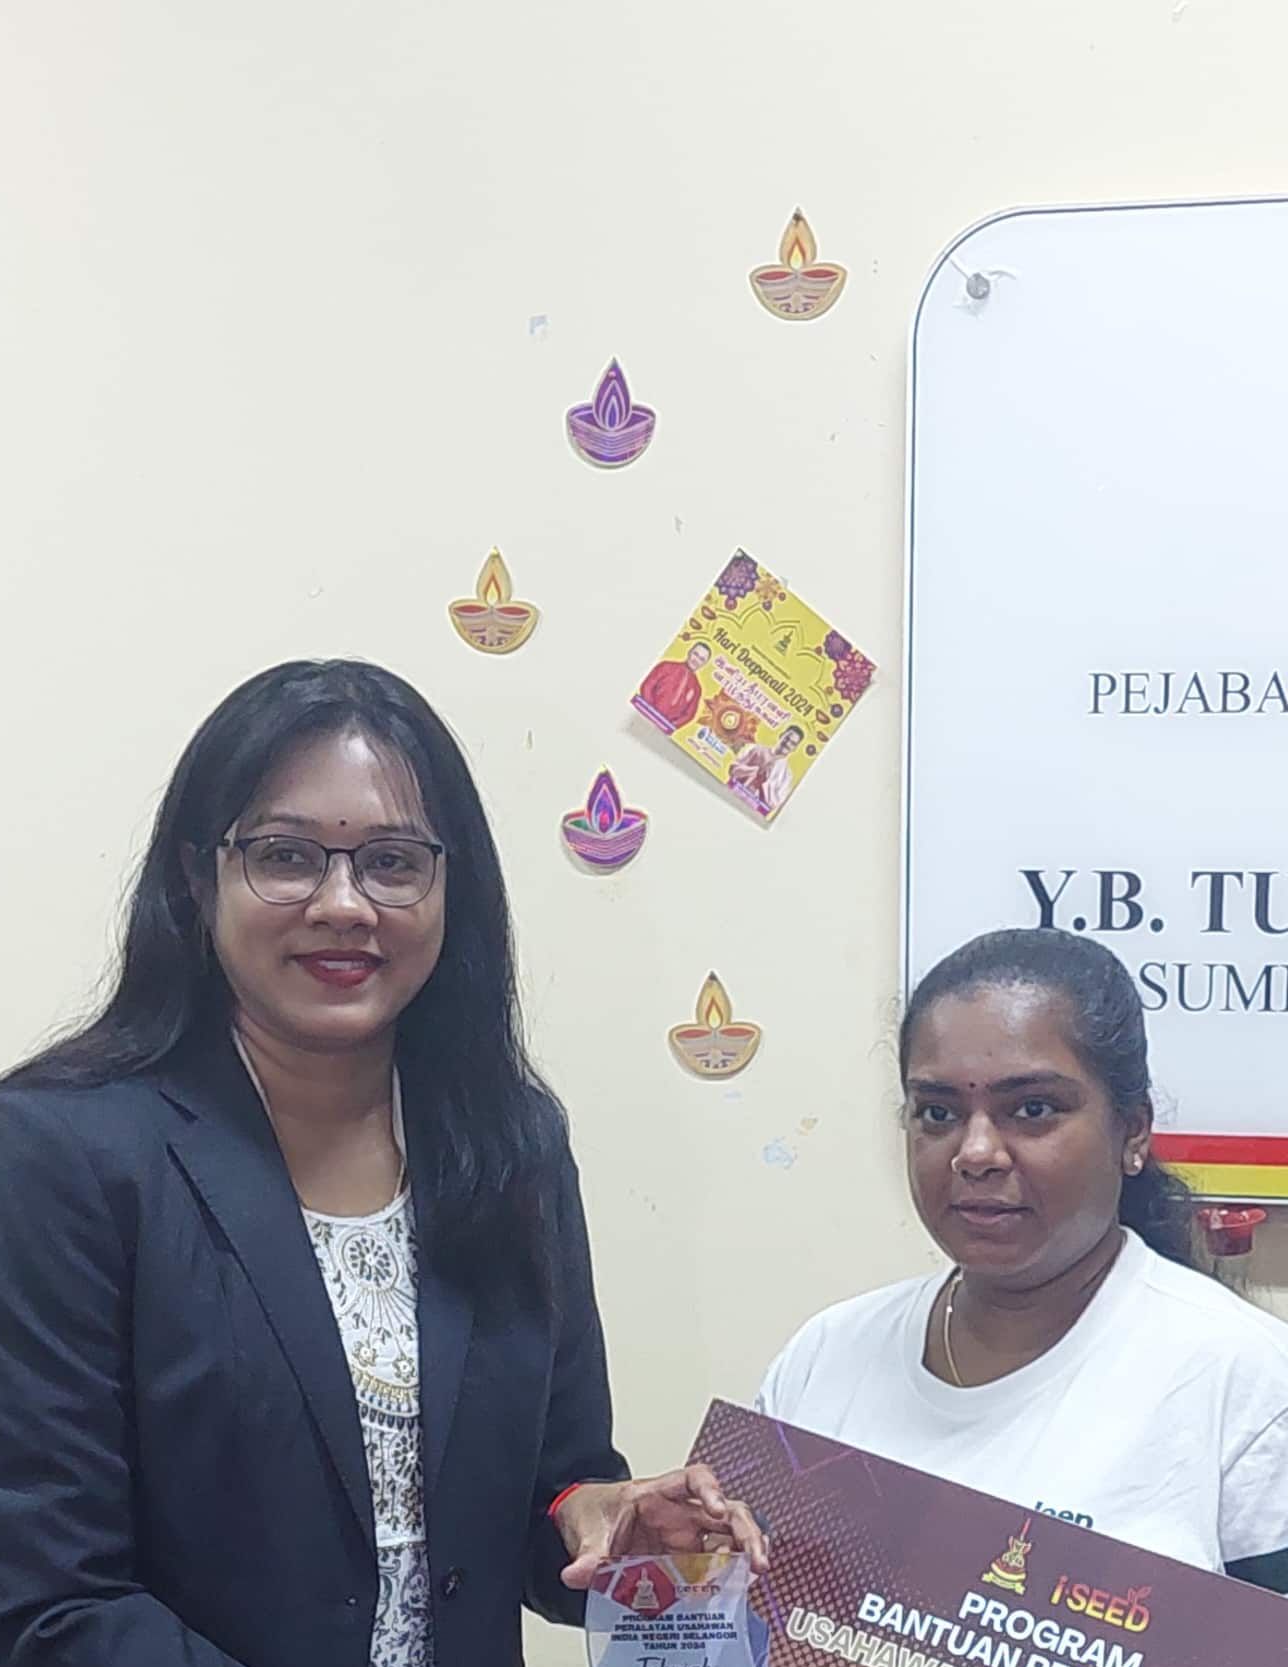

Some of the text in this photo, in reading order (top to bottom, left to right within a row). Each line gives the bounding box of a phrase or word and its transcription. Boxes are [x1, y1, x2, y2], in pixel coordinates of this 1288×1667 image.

[713, 627, 741, 655] Hari
[784, 688, 814, 716] 2024
[1018, 870, 1164, 932] Y.B.
